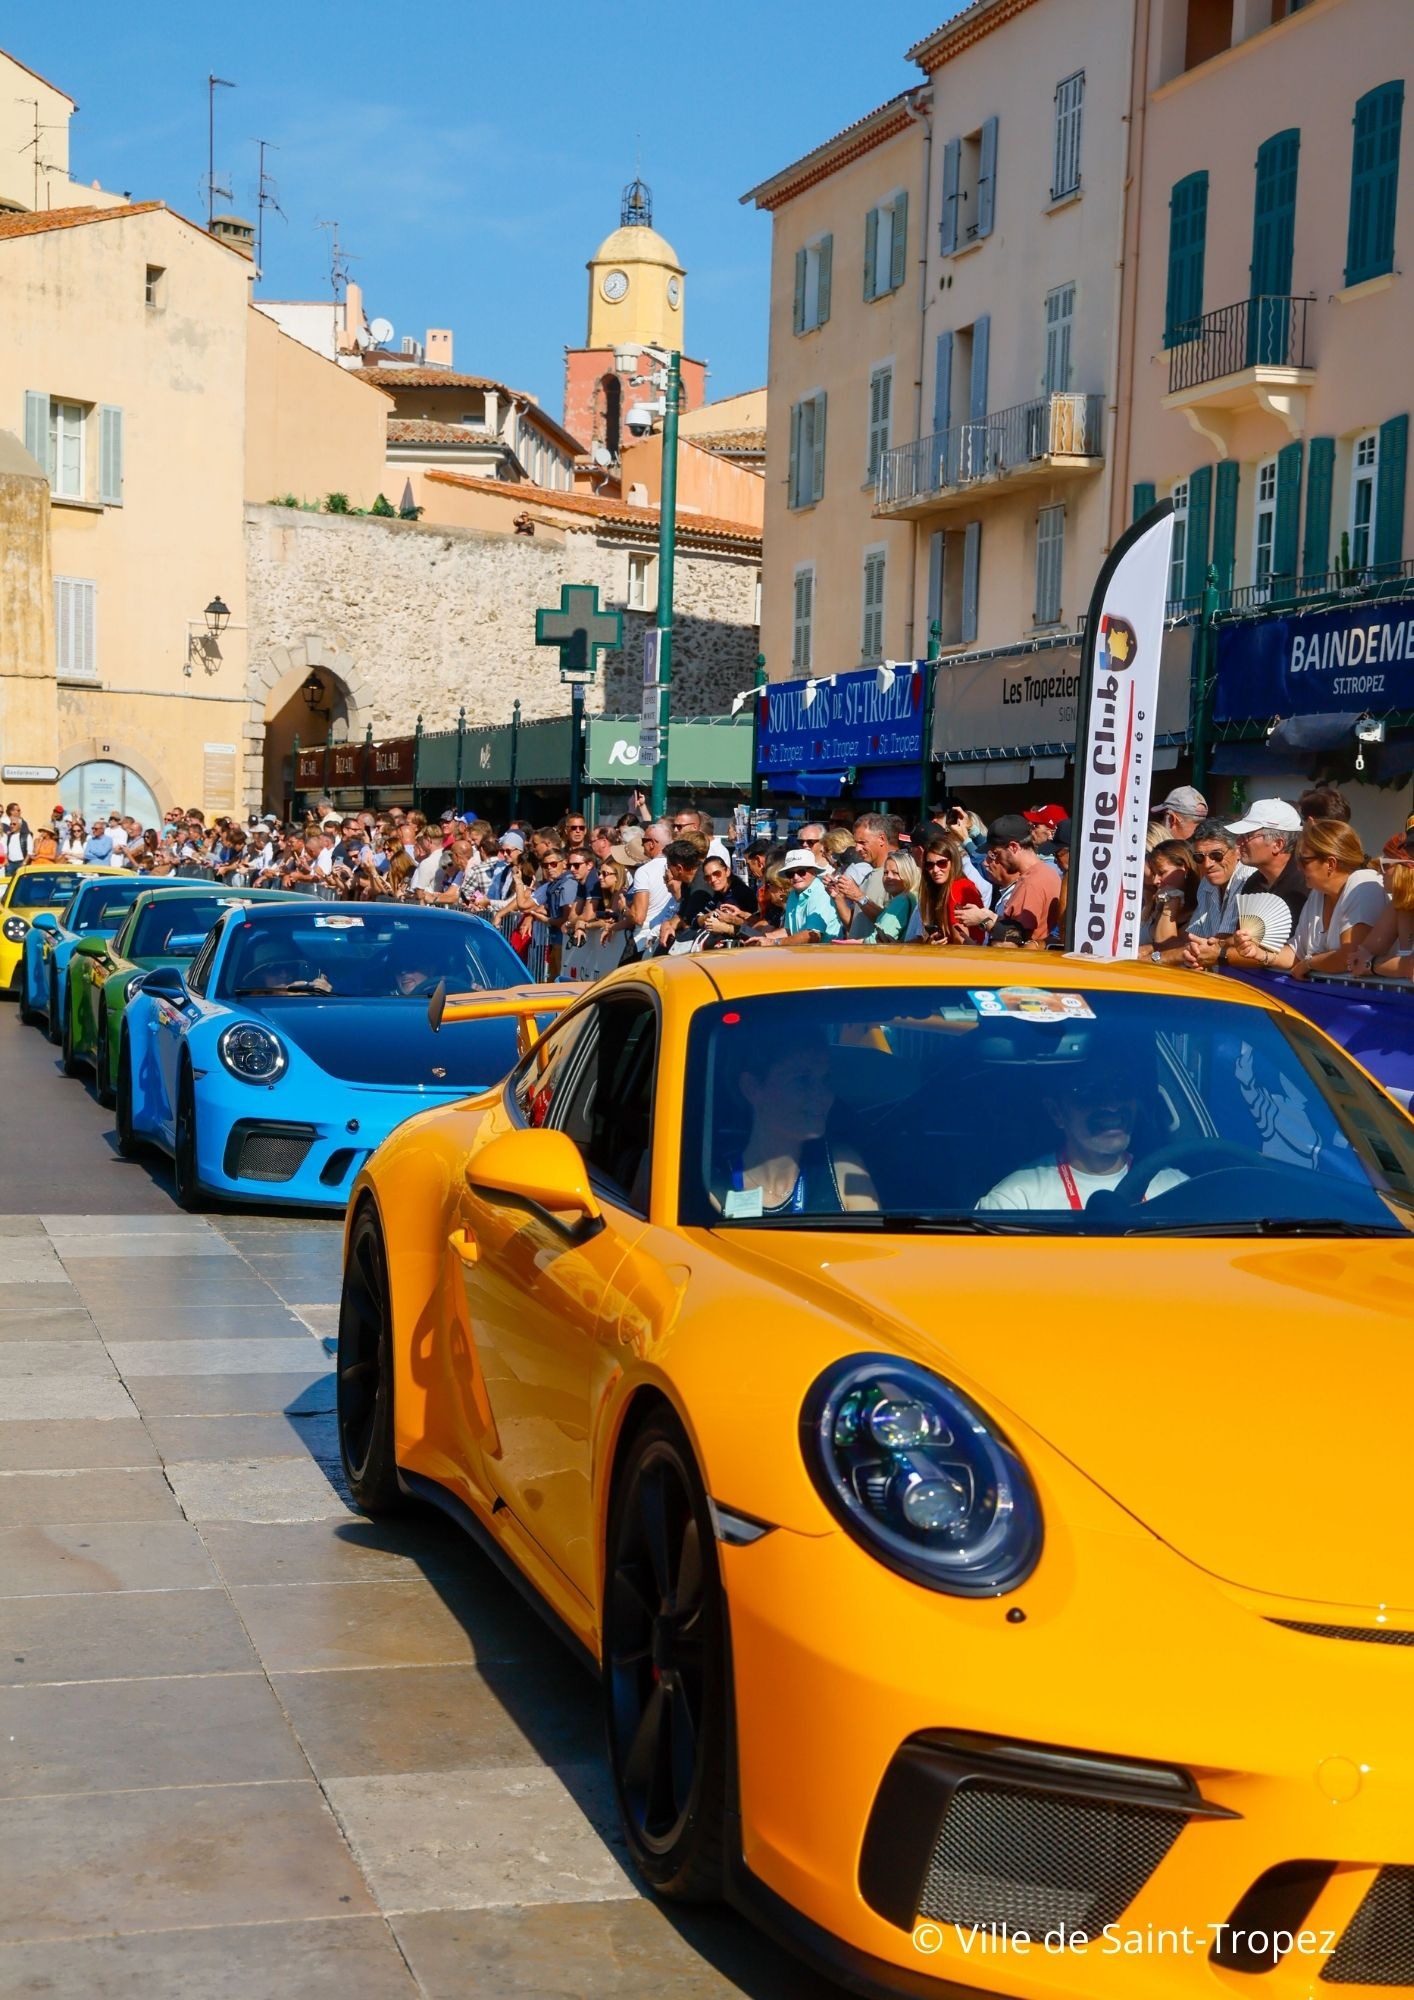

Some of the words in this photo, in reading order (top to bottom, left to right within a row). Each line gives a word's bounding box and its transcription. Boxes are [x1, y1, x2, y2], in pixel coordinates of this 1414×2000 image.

[647, 641, 655, 675] P
[1003, 678, 1022, 704] Les
[1332, 675, 1385, 694] ST.TROPEZ
[769, 687, 830, 733] SOUVENIRS
[832, 693, 843, 720] DE
[845, 674, 913, 726] ST-TROPEZ
[1092, 675, 1119, 775] Club
[758, 745, 763, 763] I
[768, 744, 778, 763] St
[779, 743, 804, 766] Tropez
[810, 740, 815, 760] I
[821, 740, 831, 759] St
[832, 738, 860, 763] Tropez
[866, 735, 872, 755] I
[878, 734, 889, 755] St
[891, 733, 919, 758] Tropez
